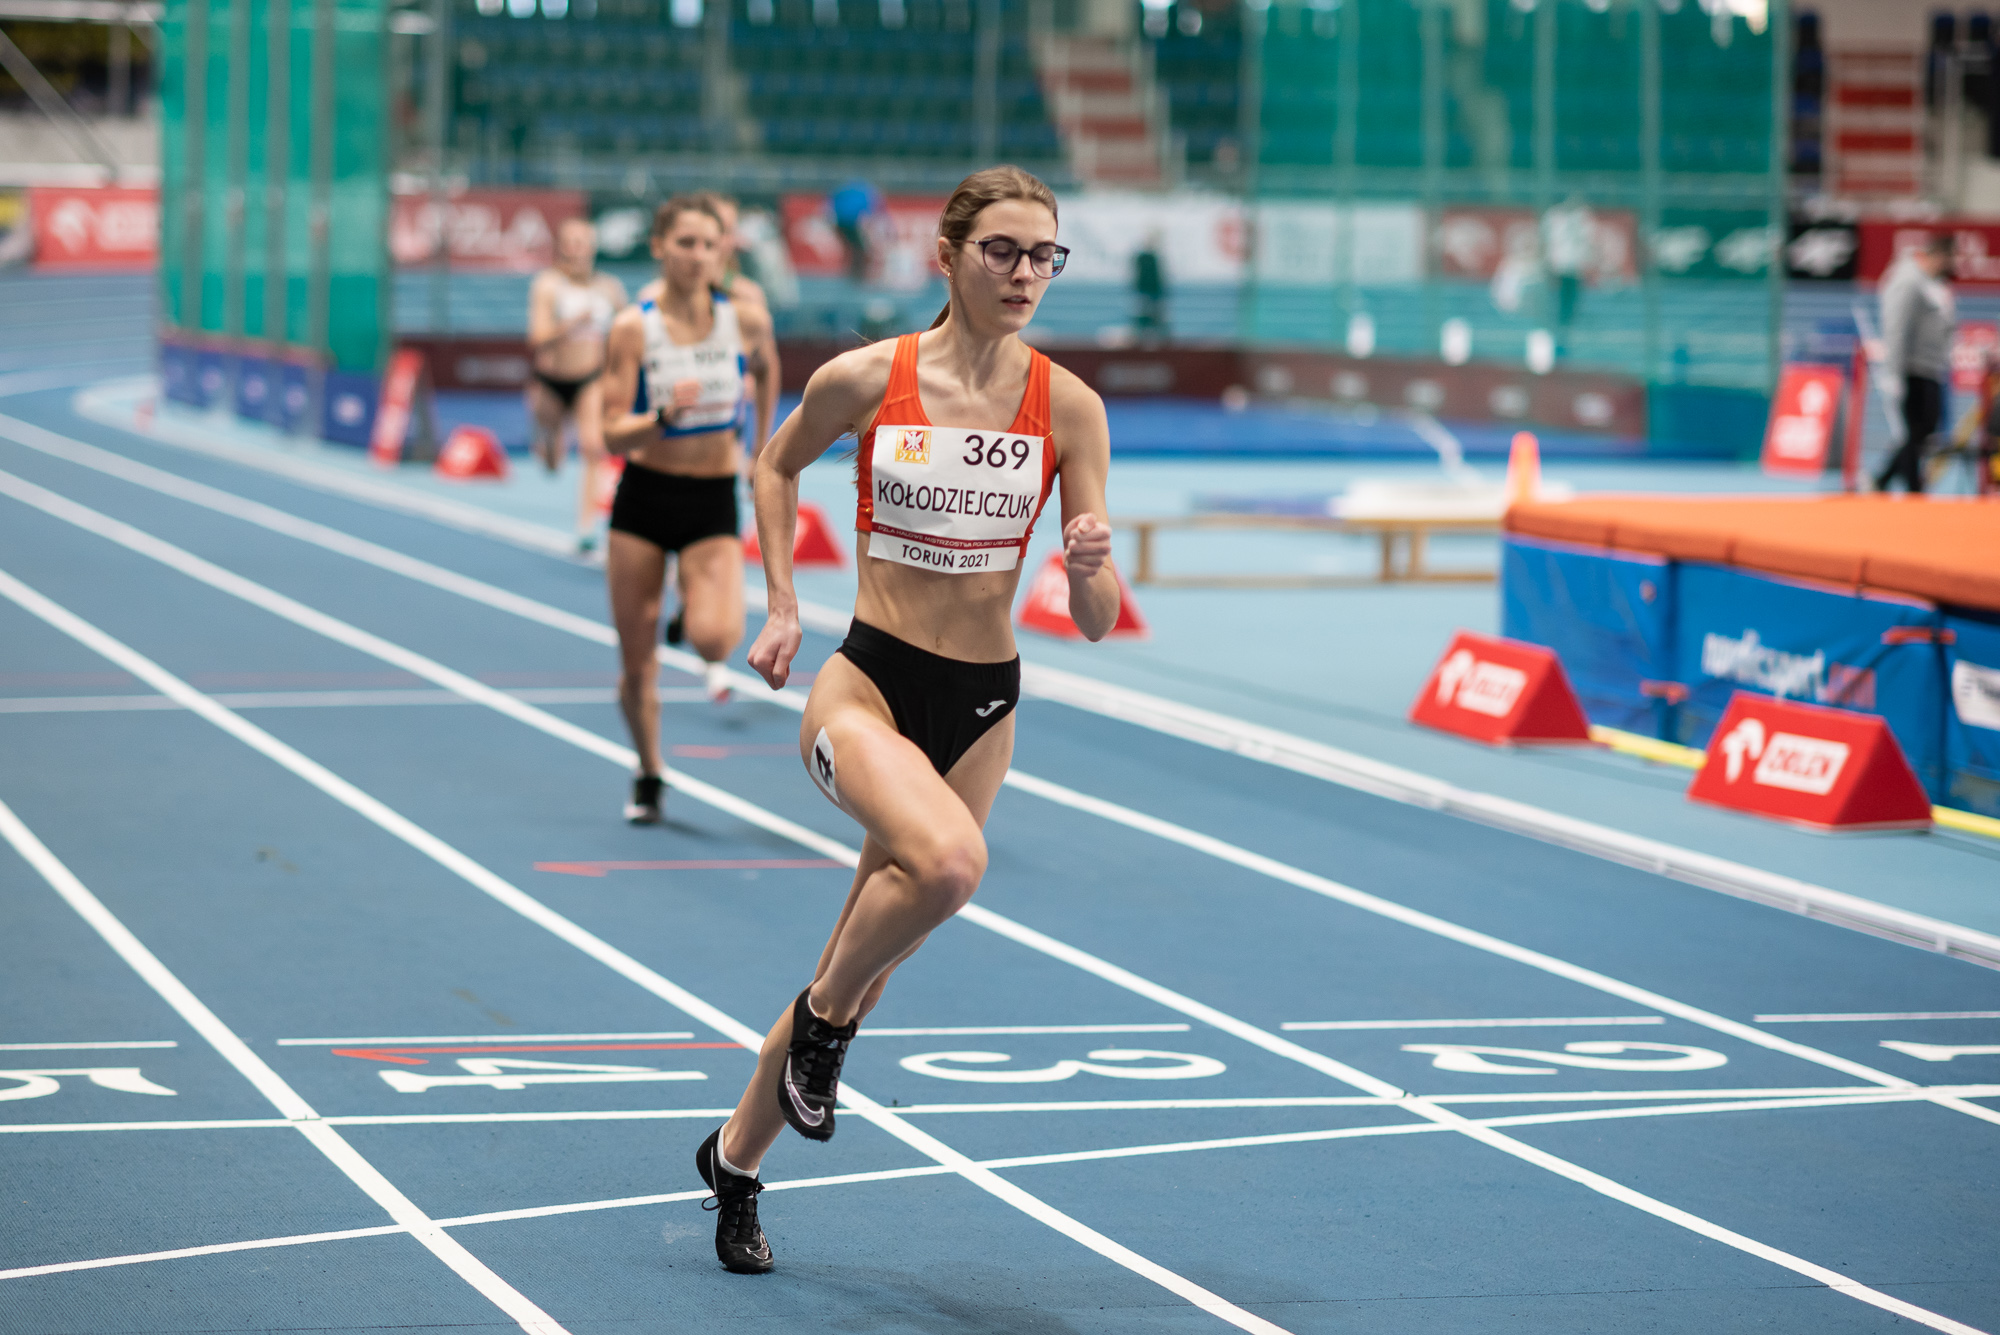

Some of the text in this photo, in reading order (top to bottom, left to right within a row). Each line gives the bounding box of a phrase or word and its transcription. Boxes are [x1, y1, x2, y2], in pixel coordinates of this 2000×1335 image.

[896, 450, 928, 463] PZLA
[963, 434, 1030, 470] 369
[878, 479, 1036, 519] KOŁODZIEJCZUK
[877, 525, 896, 534] PZLA
[896, 530, 924, 541] HALOWE
[924, 536, 972, 548] MISTRZOSTWA
[902, 543, 990, 569] TORUŃ 2021
[815, 743, 833, 790] 4
[378, 1057, 709, 1093] 4
[898, 1048, 1228, 1084] 3
[1400, 1040, 1729, 1076] 2
